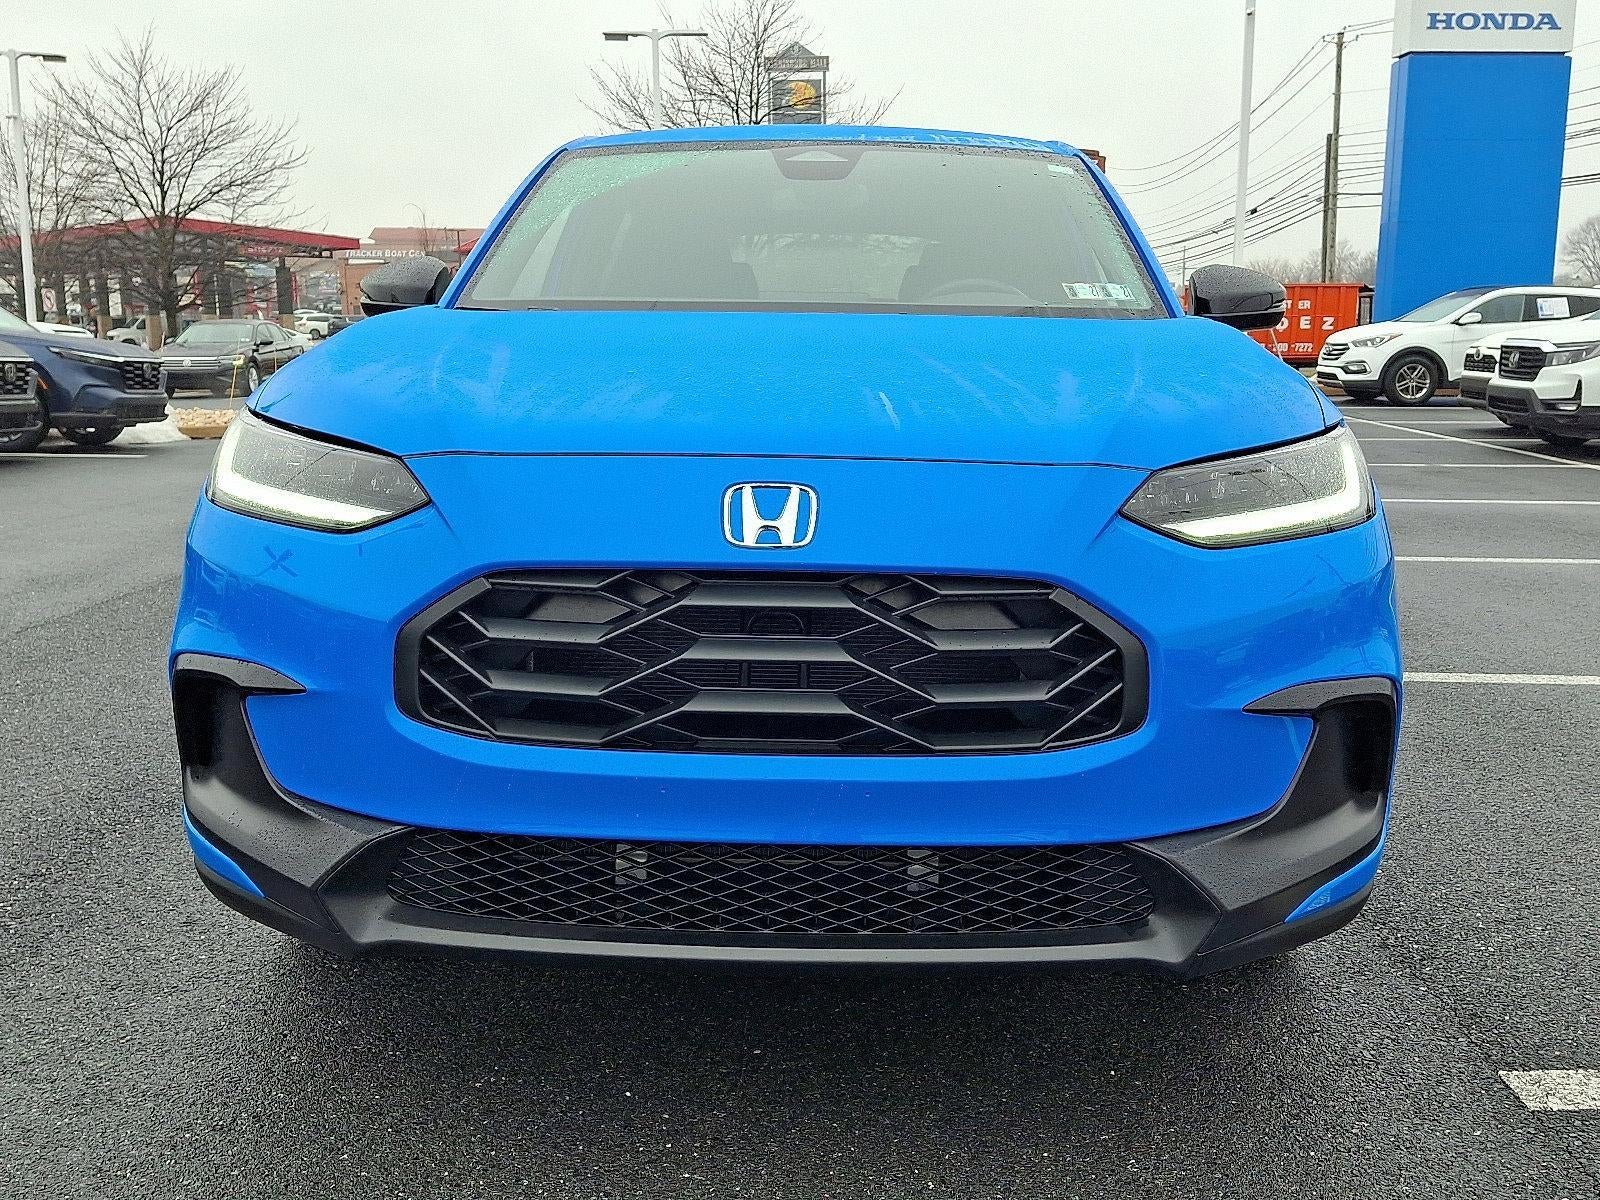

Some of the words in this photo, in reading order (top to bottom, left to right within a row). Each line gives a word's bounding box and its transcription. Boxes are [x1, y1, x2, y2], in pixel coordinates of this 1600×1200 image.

[1426, 12, 1562, 30] HONDA
[345, 249, 383, 258] TRACKER
[384, 249, 407, 258] BOAT
